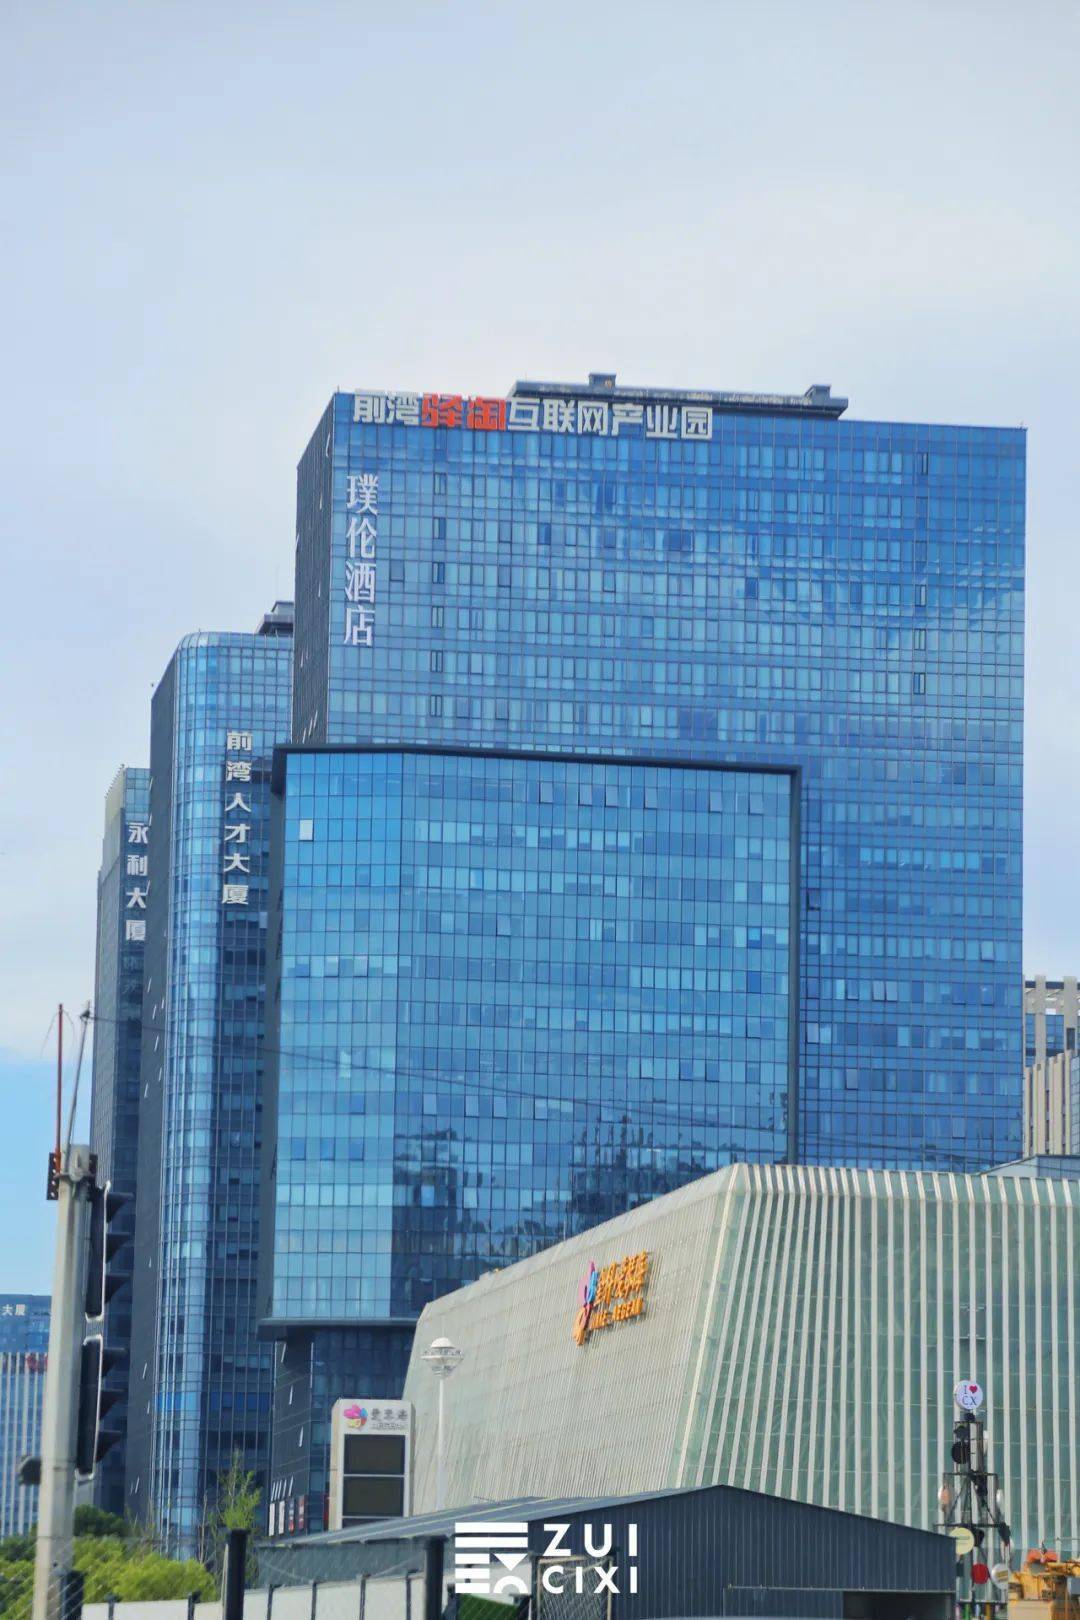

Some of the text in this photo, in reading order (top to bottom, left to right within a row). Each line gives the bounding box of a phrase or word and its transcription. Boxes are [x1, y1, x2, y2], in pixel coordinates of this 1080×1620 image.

[344, 473, 379, 646] 璞伦酒店
[126, 822, 149, 941] 永利大厦
[221, 731, 252, 905] 前湾人才大厦
